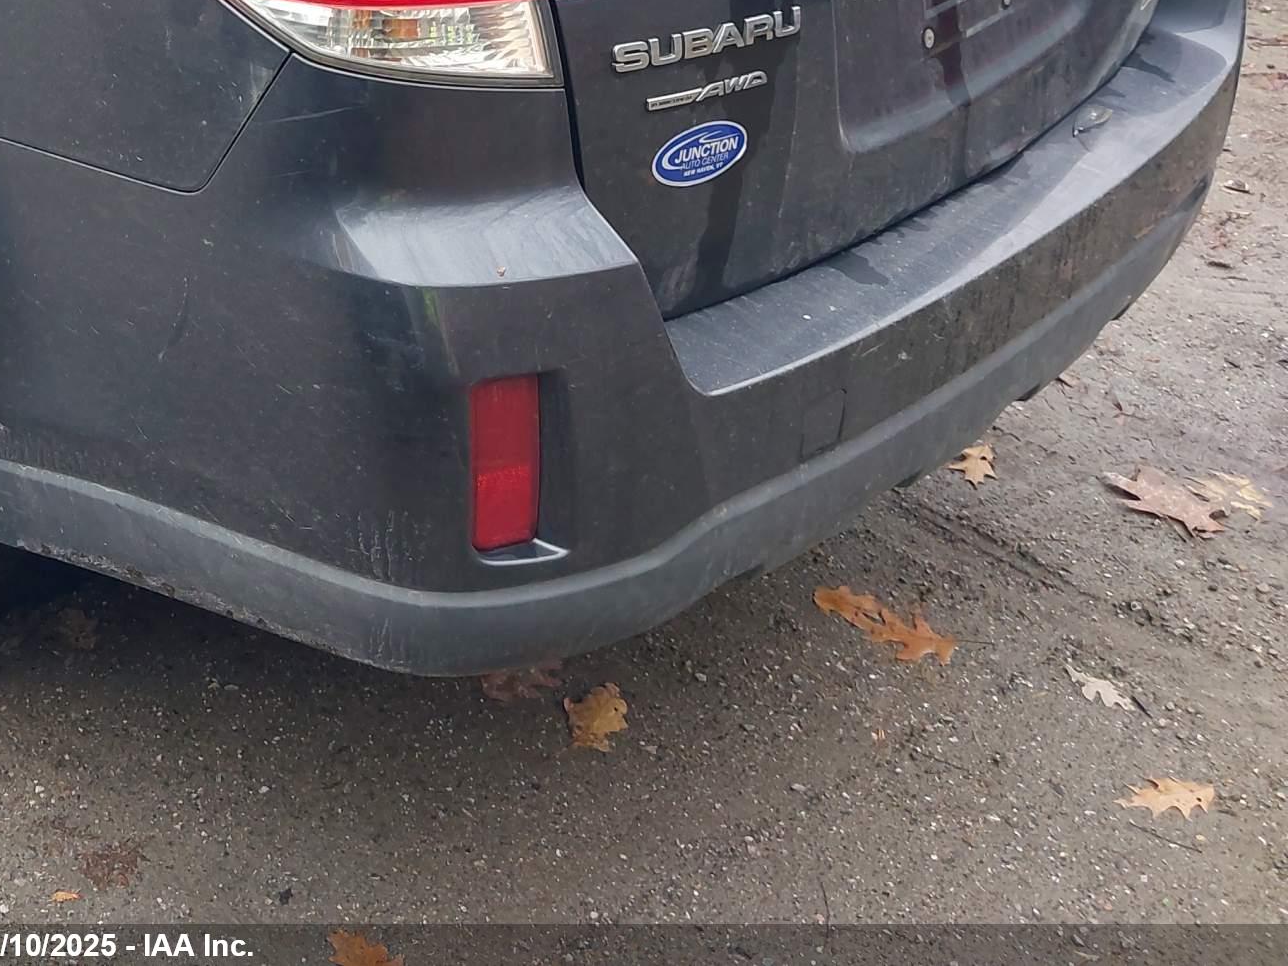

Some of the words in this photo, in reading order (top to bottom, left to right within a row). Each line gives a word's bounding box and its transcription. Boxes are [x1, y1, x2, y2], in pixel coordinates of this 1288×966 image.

[612, 5, 801, 73] SUBARU
[696, 71, 768, 102] AWD
[674, 136, 739, 164] JUNCTION
[680, 158, 701, 170] AUTO
[702, 152, 729, 165] CENTER
